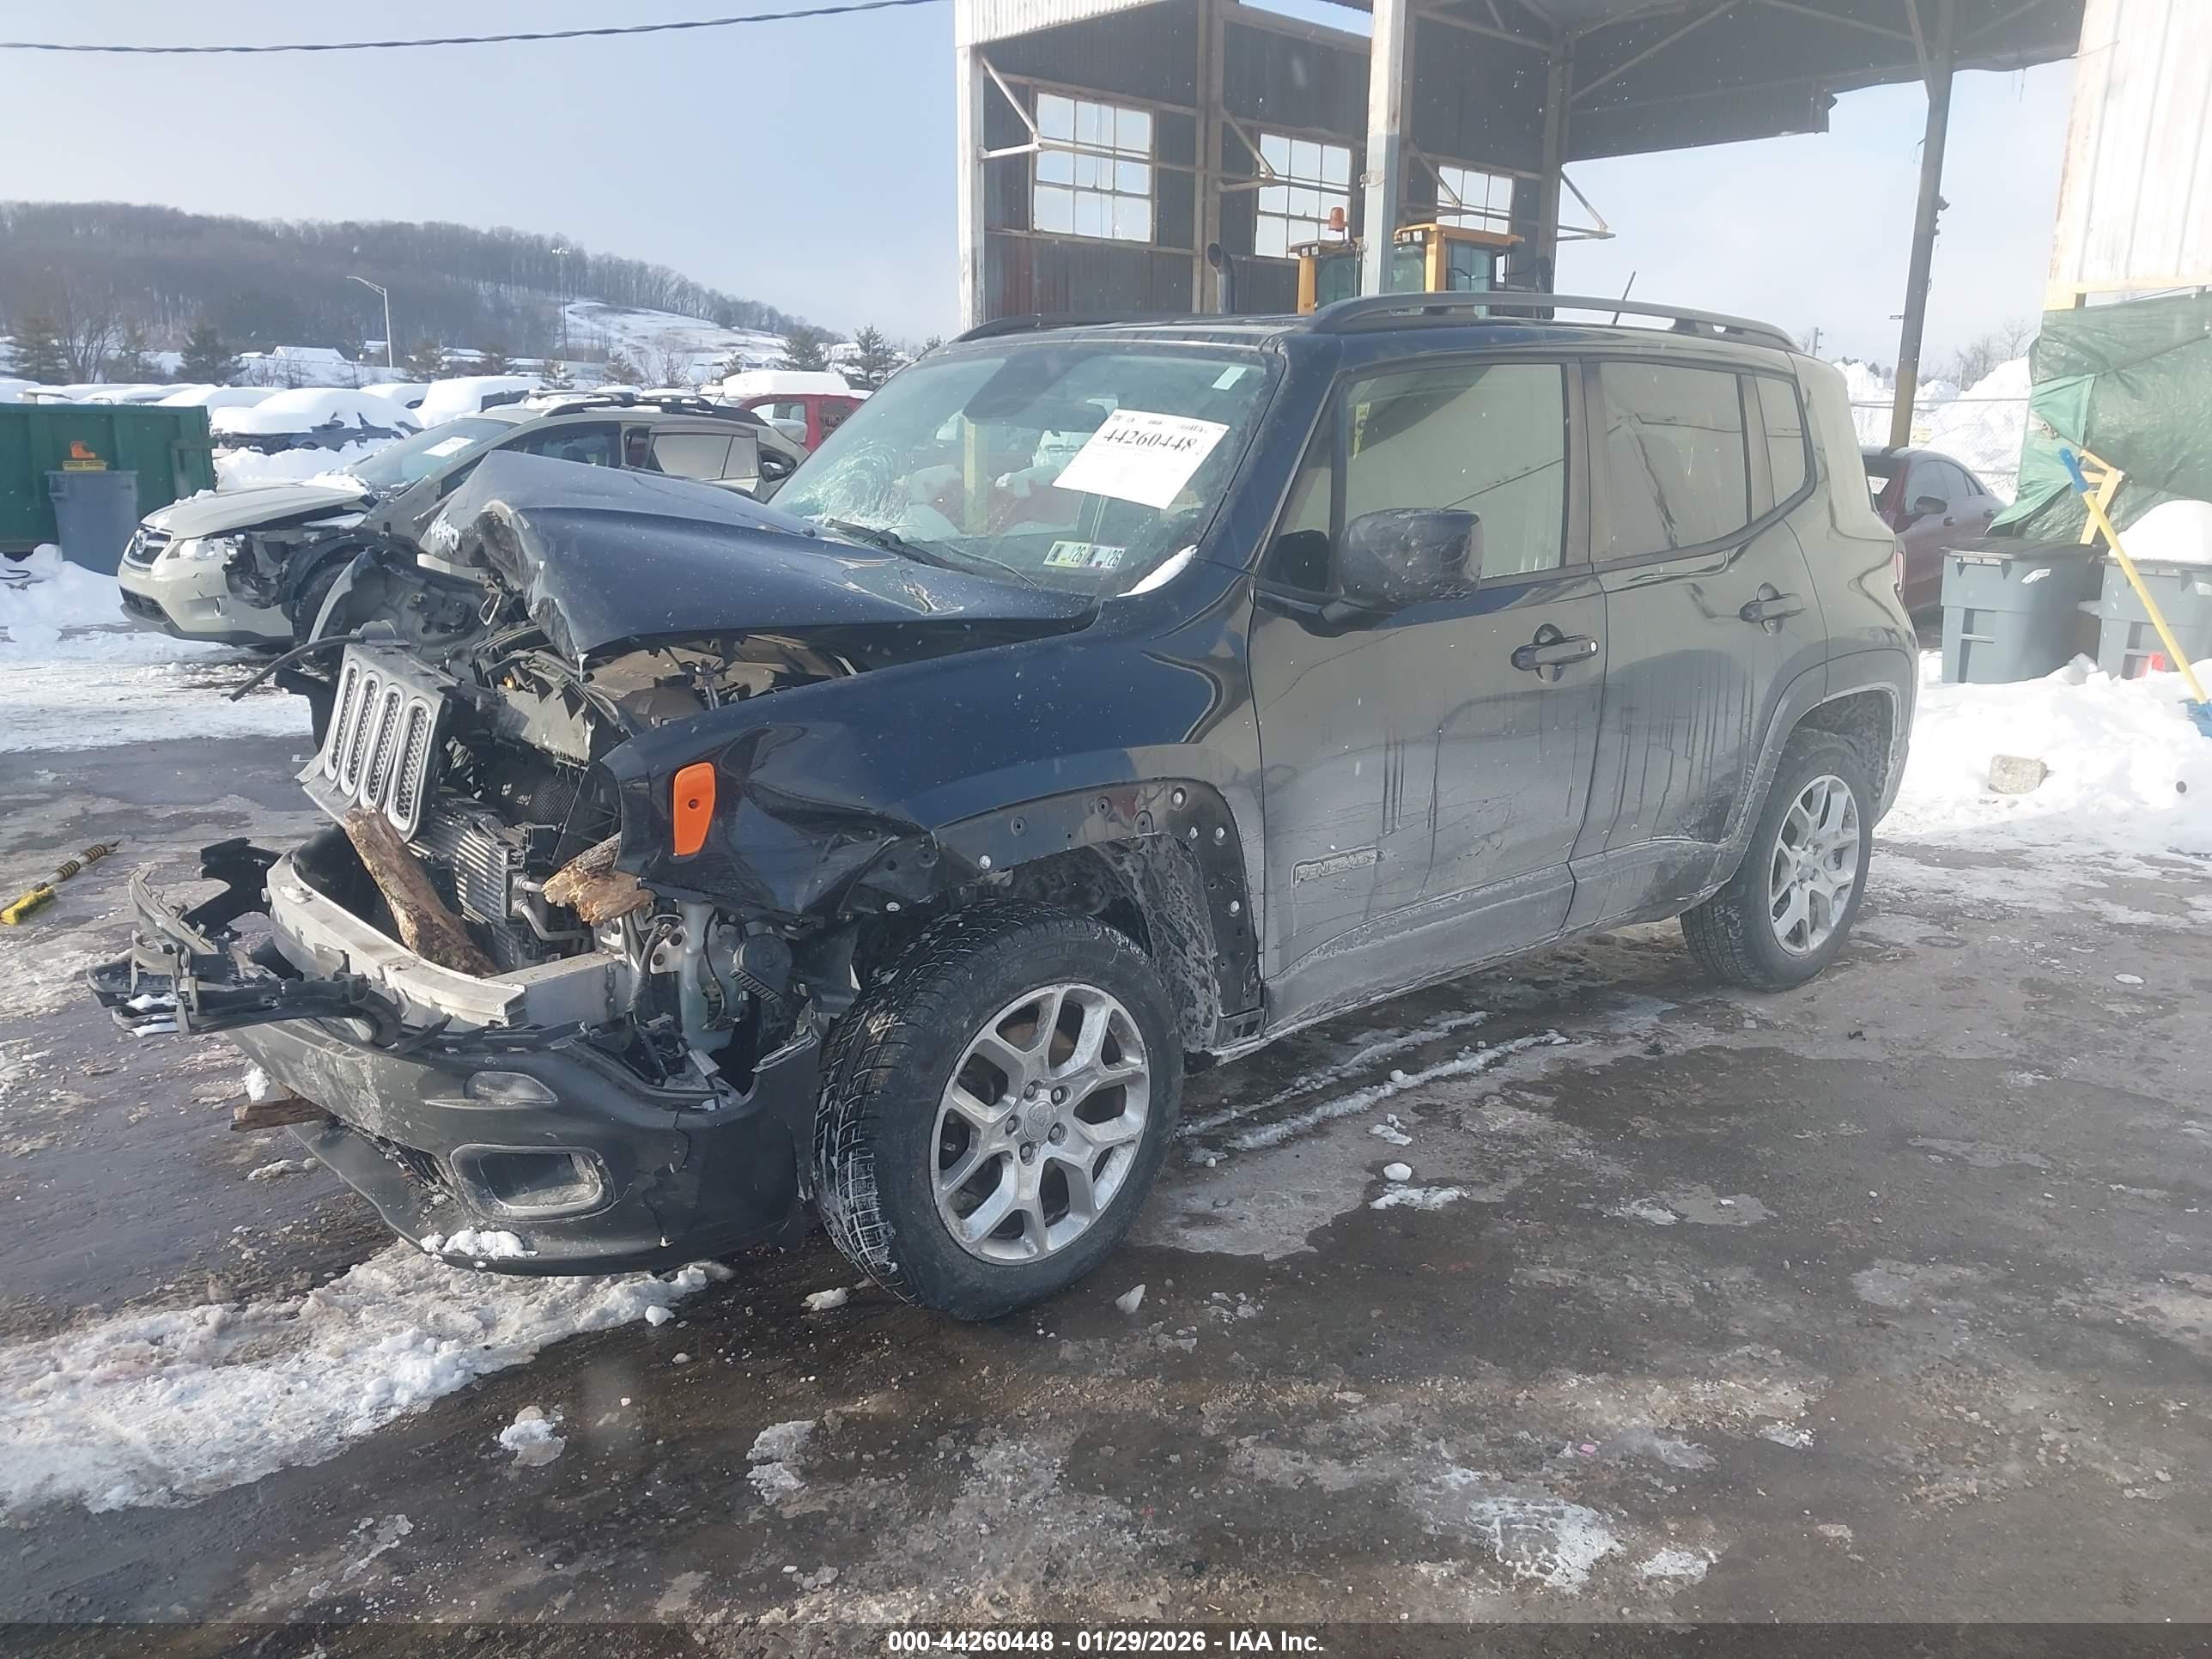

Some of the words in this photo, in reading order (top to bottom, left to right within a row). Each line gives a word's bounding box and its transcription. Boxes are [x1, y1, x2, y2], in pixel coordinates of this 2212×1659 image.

[1103, 428, 1199, 452] 44260448
[1071, 545, 1086, 563] 26
[1107, 549, 1123, 567] 26
